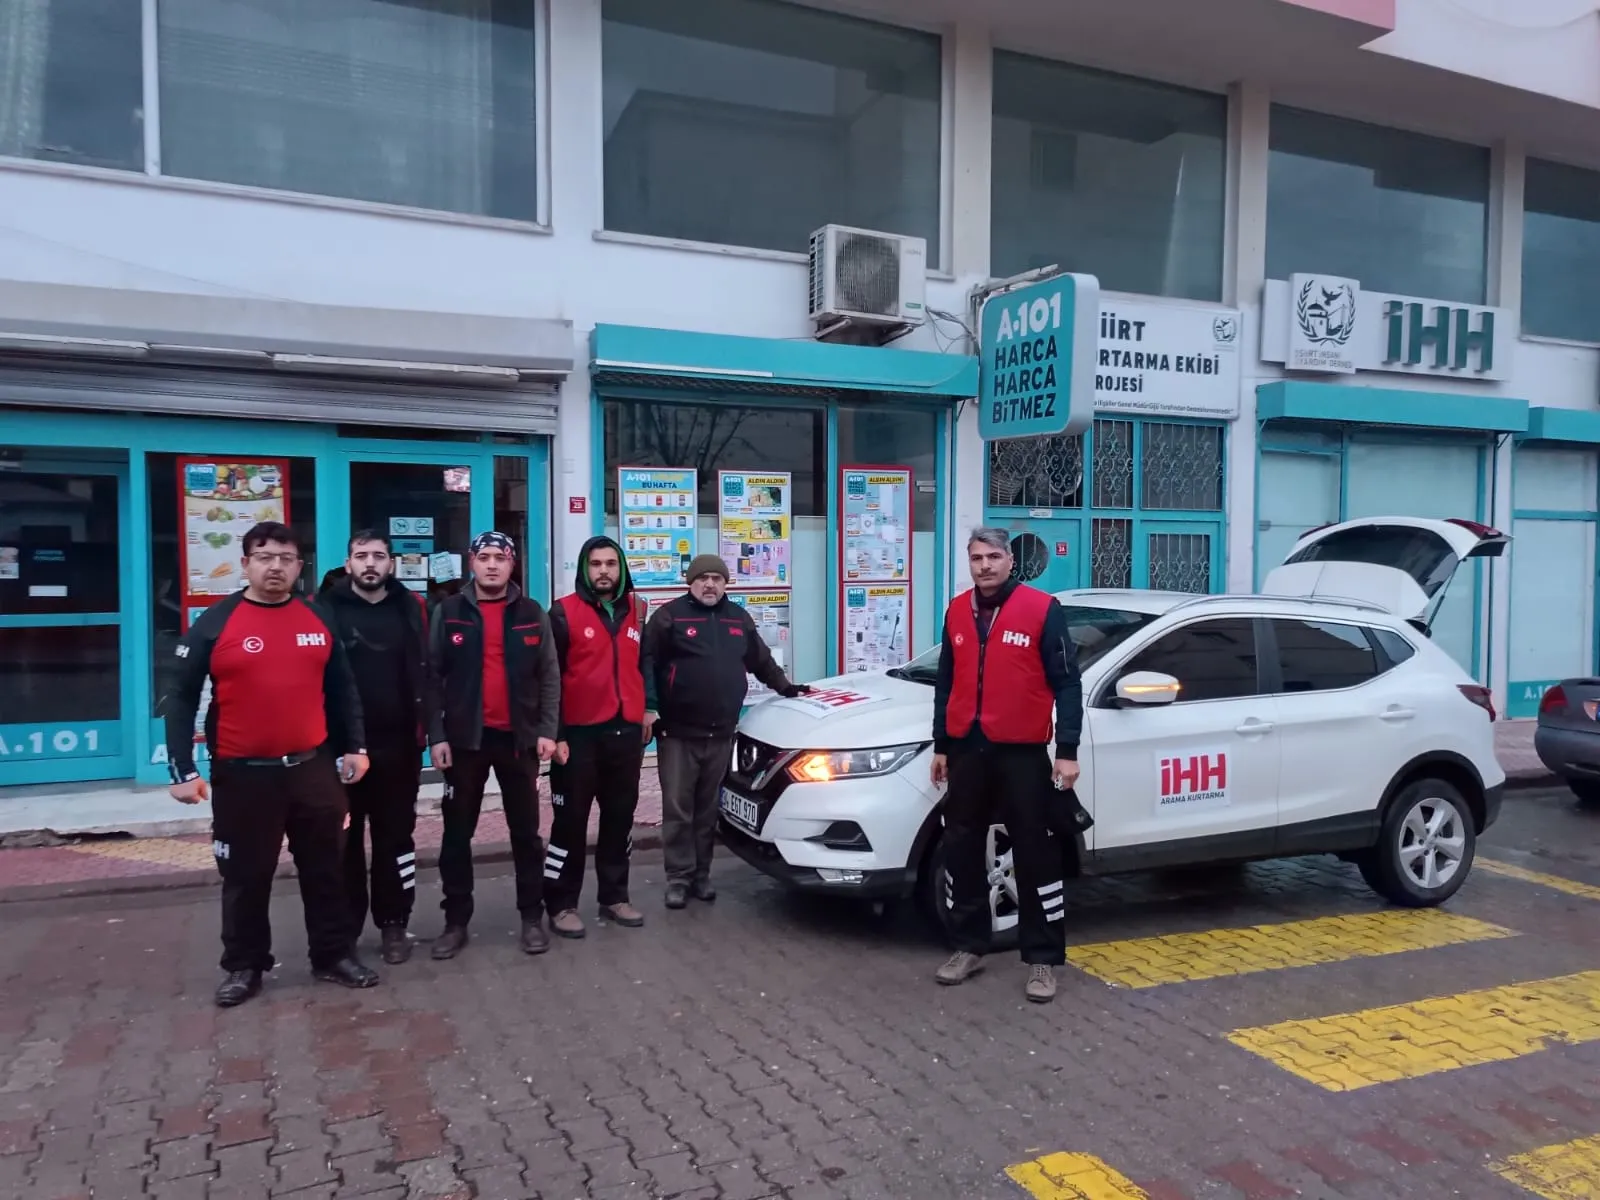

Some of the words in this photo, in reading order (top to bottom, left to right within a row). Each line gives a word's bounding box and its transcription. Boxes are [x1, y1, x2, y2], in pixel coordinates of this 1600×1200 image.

[1100, 311, 1146, 342] İİRT
[994, 335, 1058, 371] HARCA
[1096, 350, 1170, 372] RTARMA
[1175, 352, 1220, 375] EKİBİ
[993, 364, 1057, 397] HARCA
[1096, 374, 1144, 393] ROJESİ
[992, 393, 1056, 423] BİTMEZ
[1161, 753, 1226, 796] İHH
[1161, 796, 1186, 805] ARAMA
[1187, 791, 1225, 801] KURTARMA
